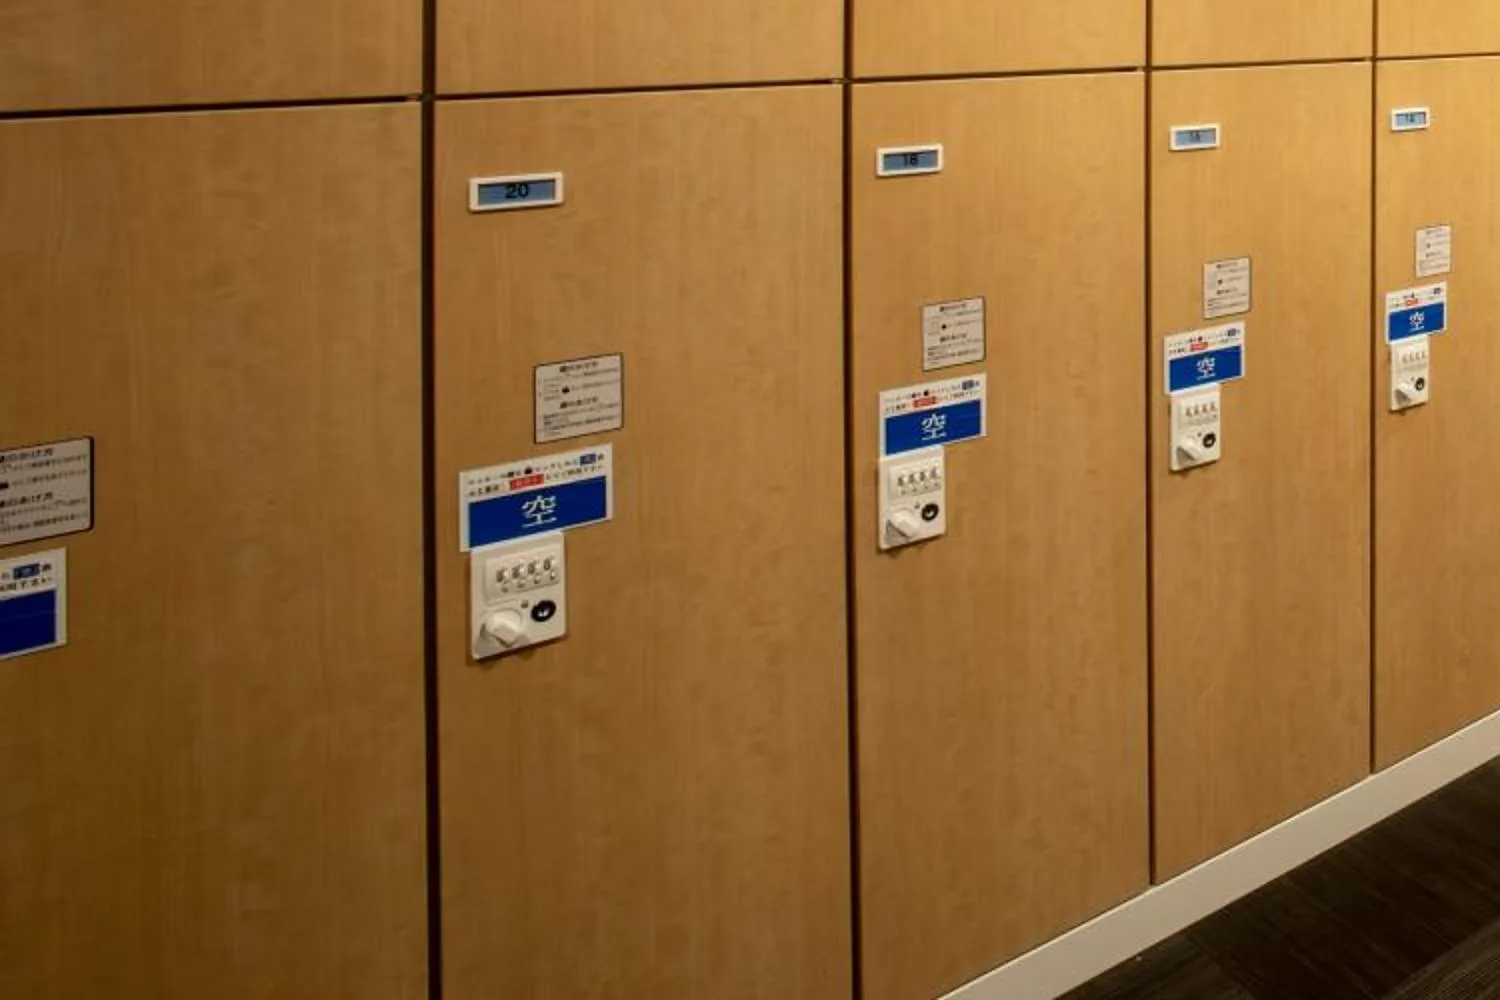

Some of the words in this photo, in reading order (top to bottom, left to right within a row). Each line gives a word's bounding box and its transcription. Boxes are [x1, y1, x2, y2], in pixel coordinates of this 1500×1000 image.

[505, 182, 529, 199] 20
[1409, 311, 1424, 332] 空
[1196, 357, 1216, 381] 空
[921, 412, 947, 441] 空
[521, 495, 558, 528] 空
